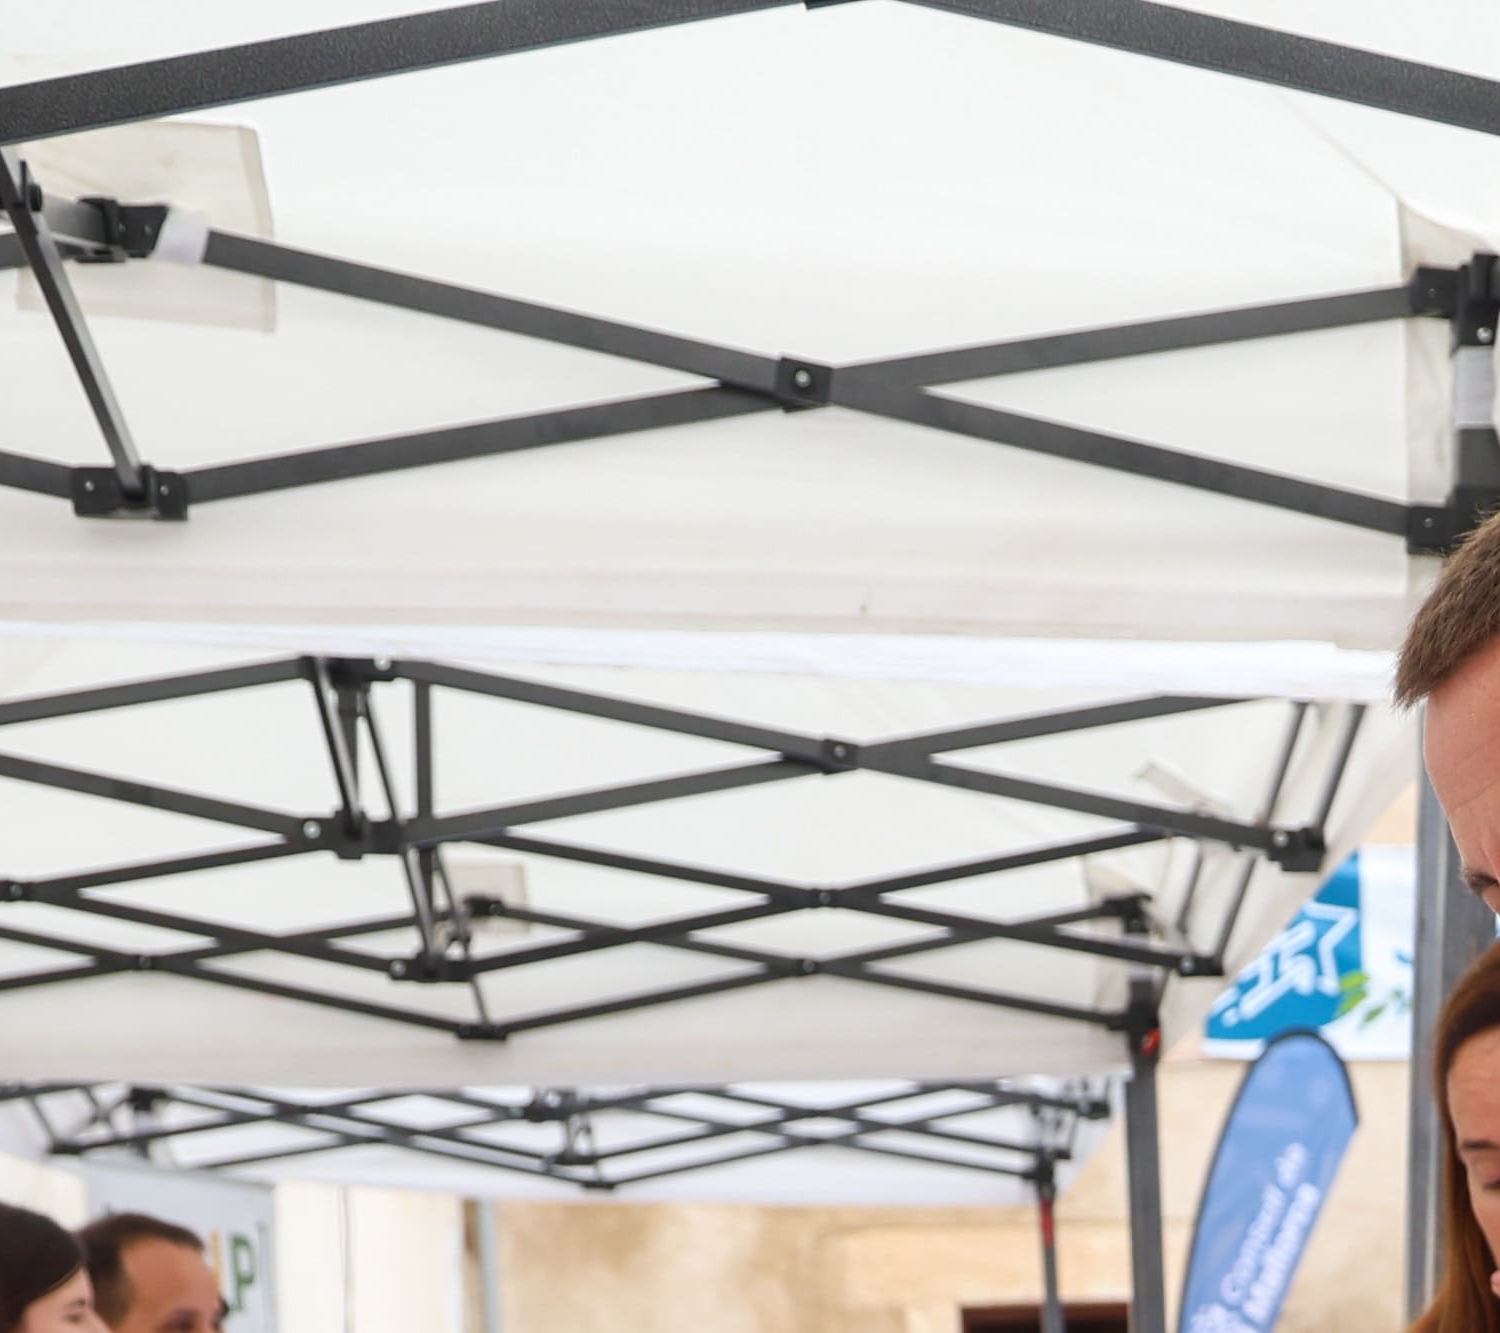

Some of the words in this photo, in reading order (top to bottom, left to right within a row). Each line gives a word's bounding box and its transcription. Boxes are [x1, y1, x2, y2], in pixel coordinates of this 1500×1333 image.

[1219, 1182, 1284, 1306] Consell
[1275, 1141, 1308, 1186] de
[1241, 1182, 1320, 1331] Mallorca
